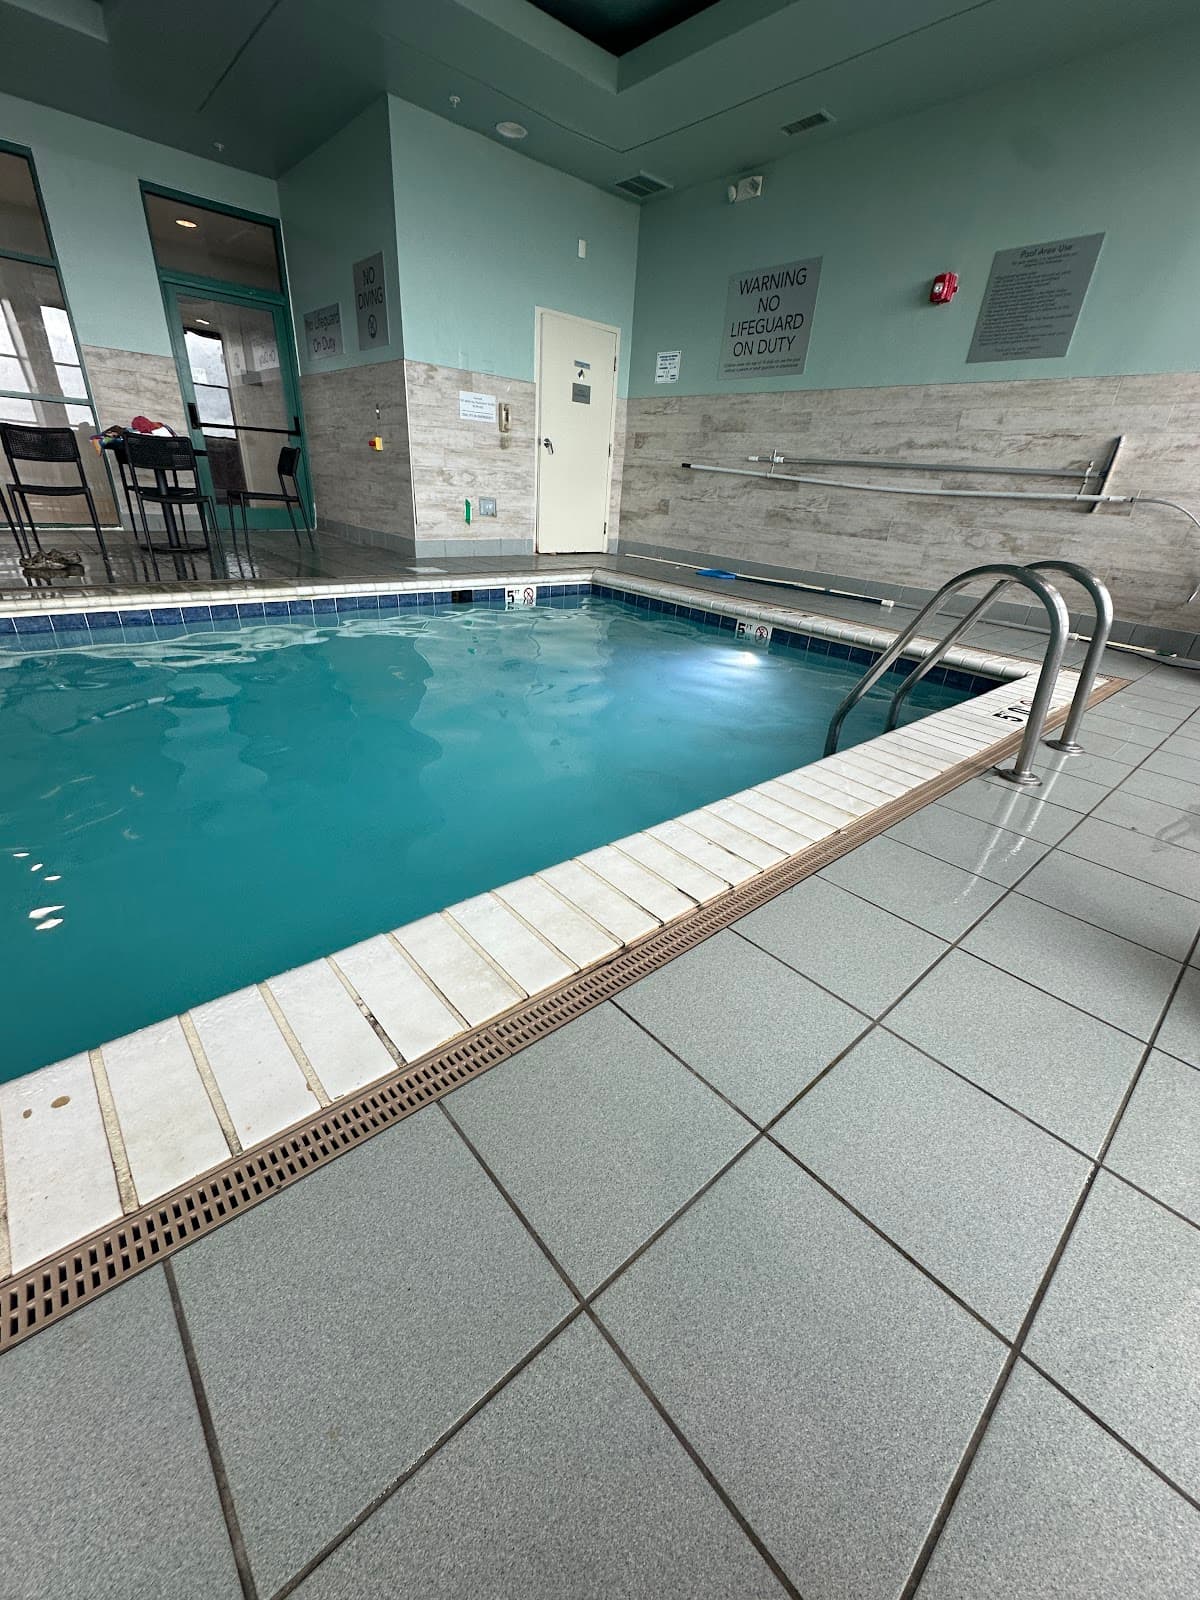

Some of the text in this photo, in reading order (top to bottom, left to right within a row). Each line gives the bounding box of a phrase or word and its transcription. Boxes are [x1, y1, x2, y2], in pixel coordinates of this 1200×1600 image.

[1020, 243, 1073, 258] Pool Area Use
[362, 266, 376, 286] NO
[739, 267, 808, 296] WARNING
[358, 286, 384, 310] DIVING
[757, 294, 781, 313] NO
[730, 313, 805, 338] LIFEGUARD
[313, 336, 336, 353] On Duty
[733, 335, 797, 357] ON DUTY
[507, 590, 515, 602] 5
[738, 622, 746, 633] 5
